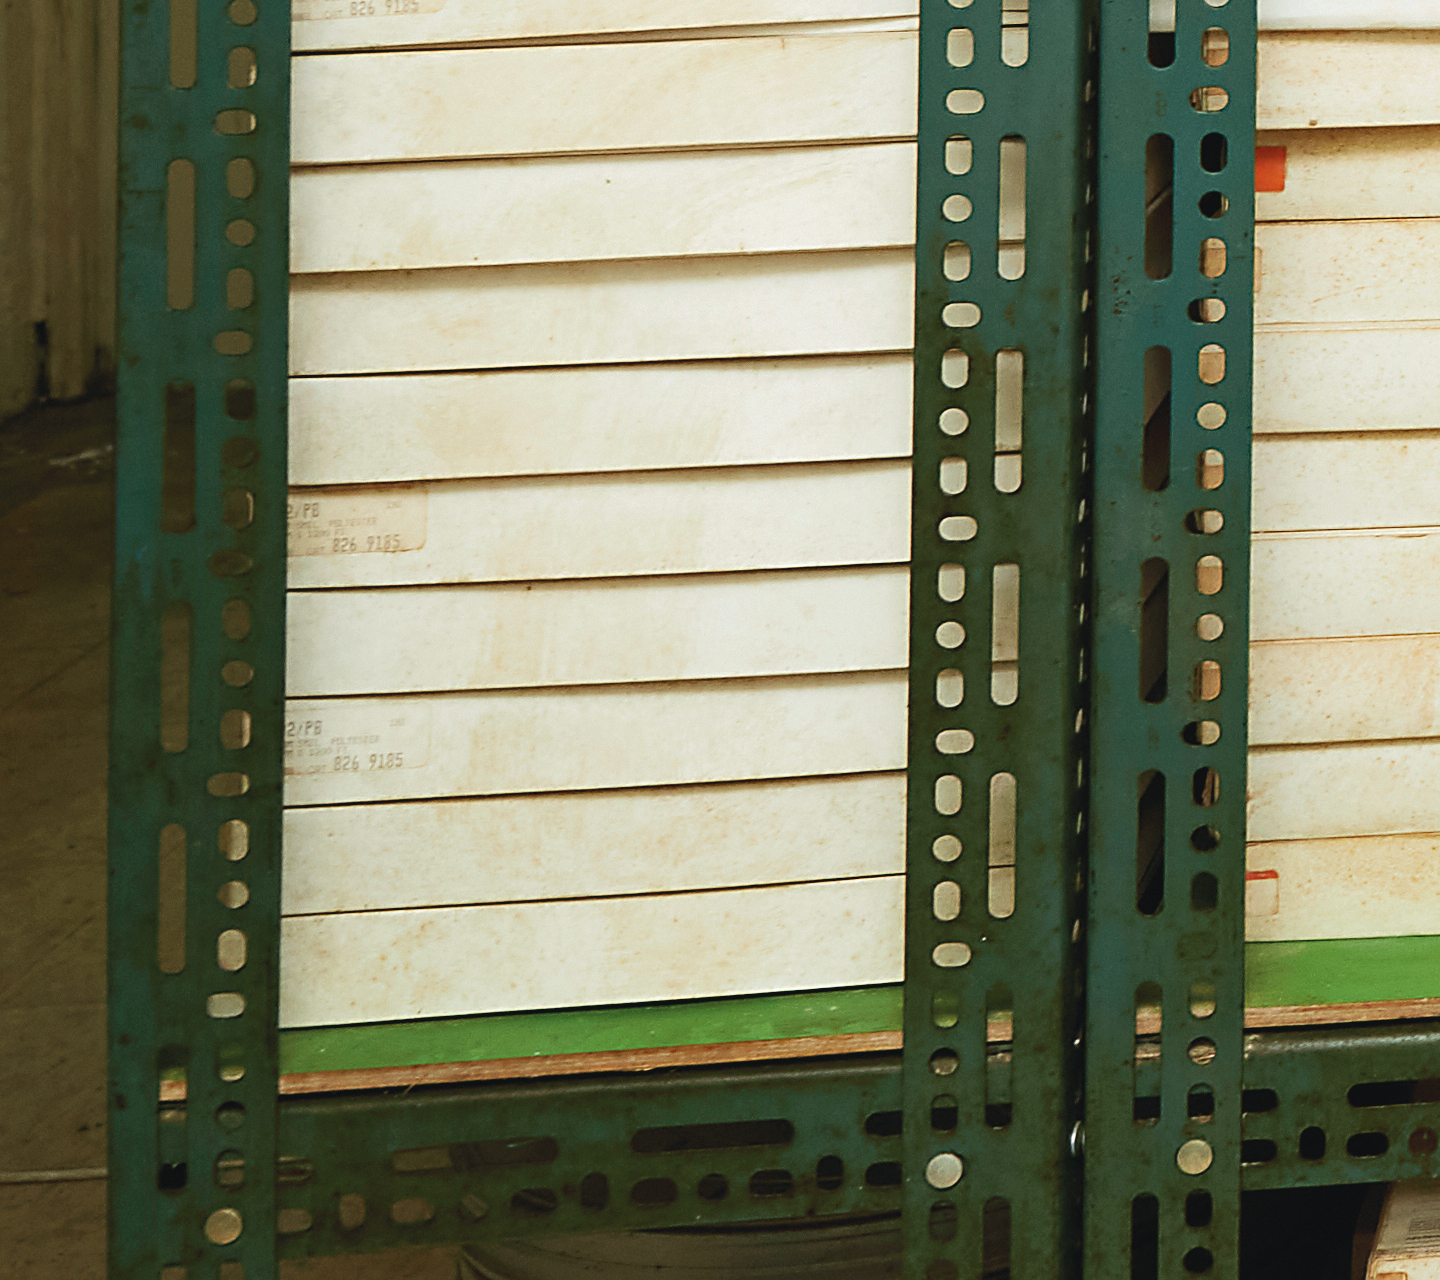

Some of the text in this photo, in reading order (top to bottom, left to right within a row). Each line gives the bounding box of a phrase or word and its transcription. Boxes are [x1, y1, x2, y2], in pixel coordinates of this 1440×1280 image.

[351, 1, 376, 16] 826
[332, 538, 357, 552] 826
[333, 752, 403, 771] 826 9185
